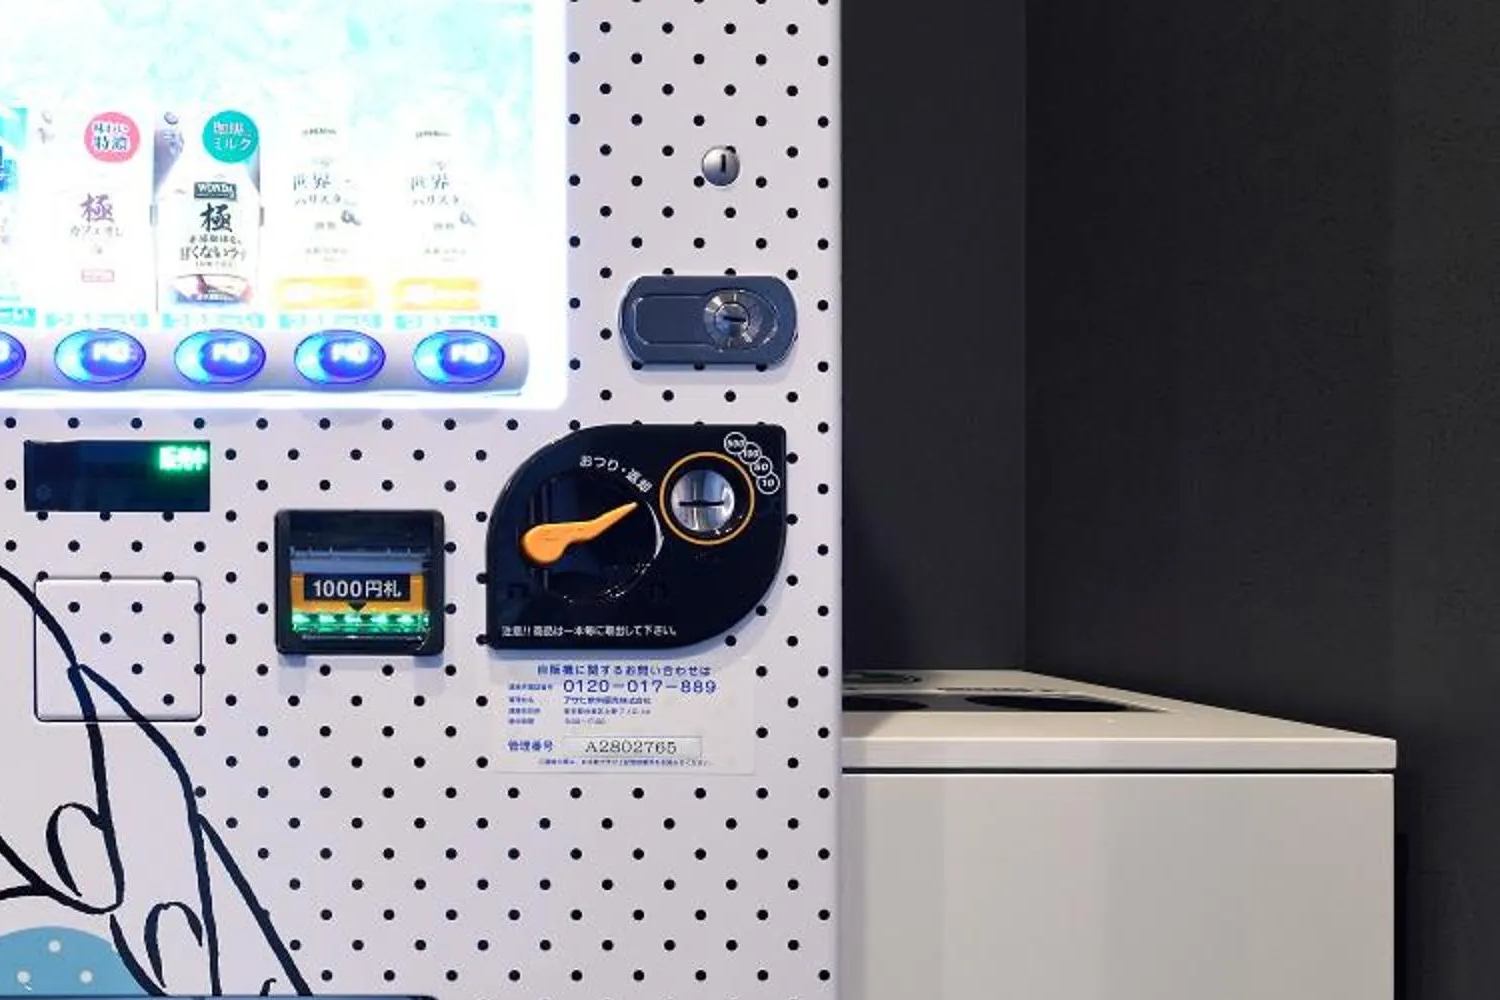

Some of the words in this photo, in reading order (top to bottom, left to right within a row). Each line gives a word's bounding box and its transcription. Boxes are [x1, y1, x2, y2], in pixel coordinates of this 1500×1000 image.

[197, 183, 234, 194] WONDA
[80, 191, 115, 222] 極
[199, 202, 233, 232] 極
[312, 579, 402, 598] 1000円札
[537, 664, 712, 677] 自販機に関するお問い合わせは
[585, 741, 678, 755] A2802765
